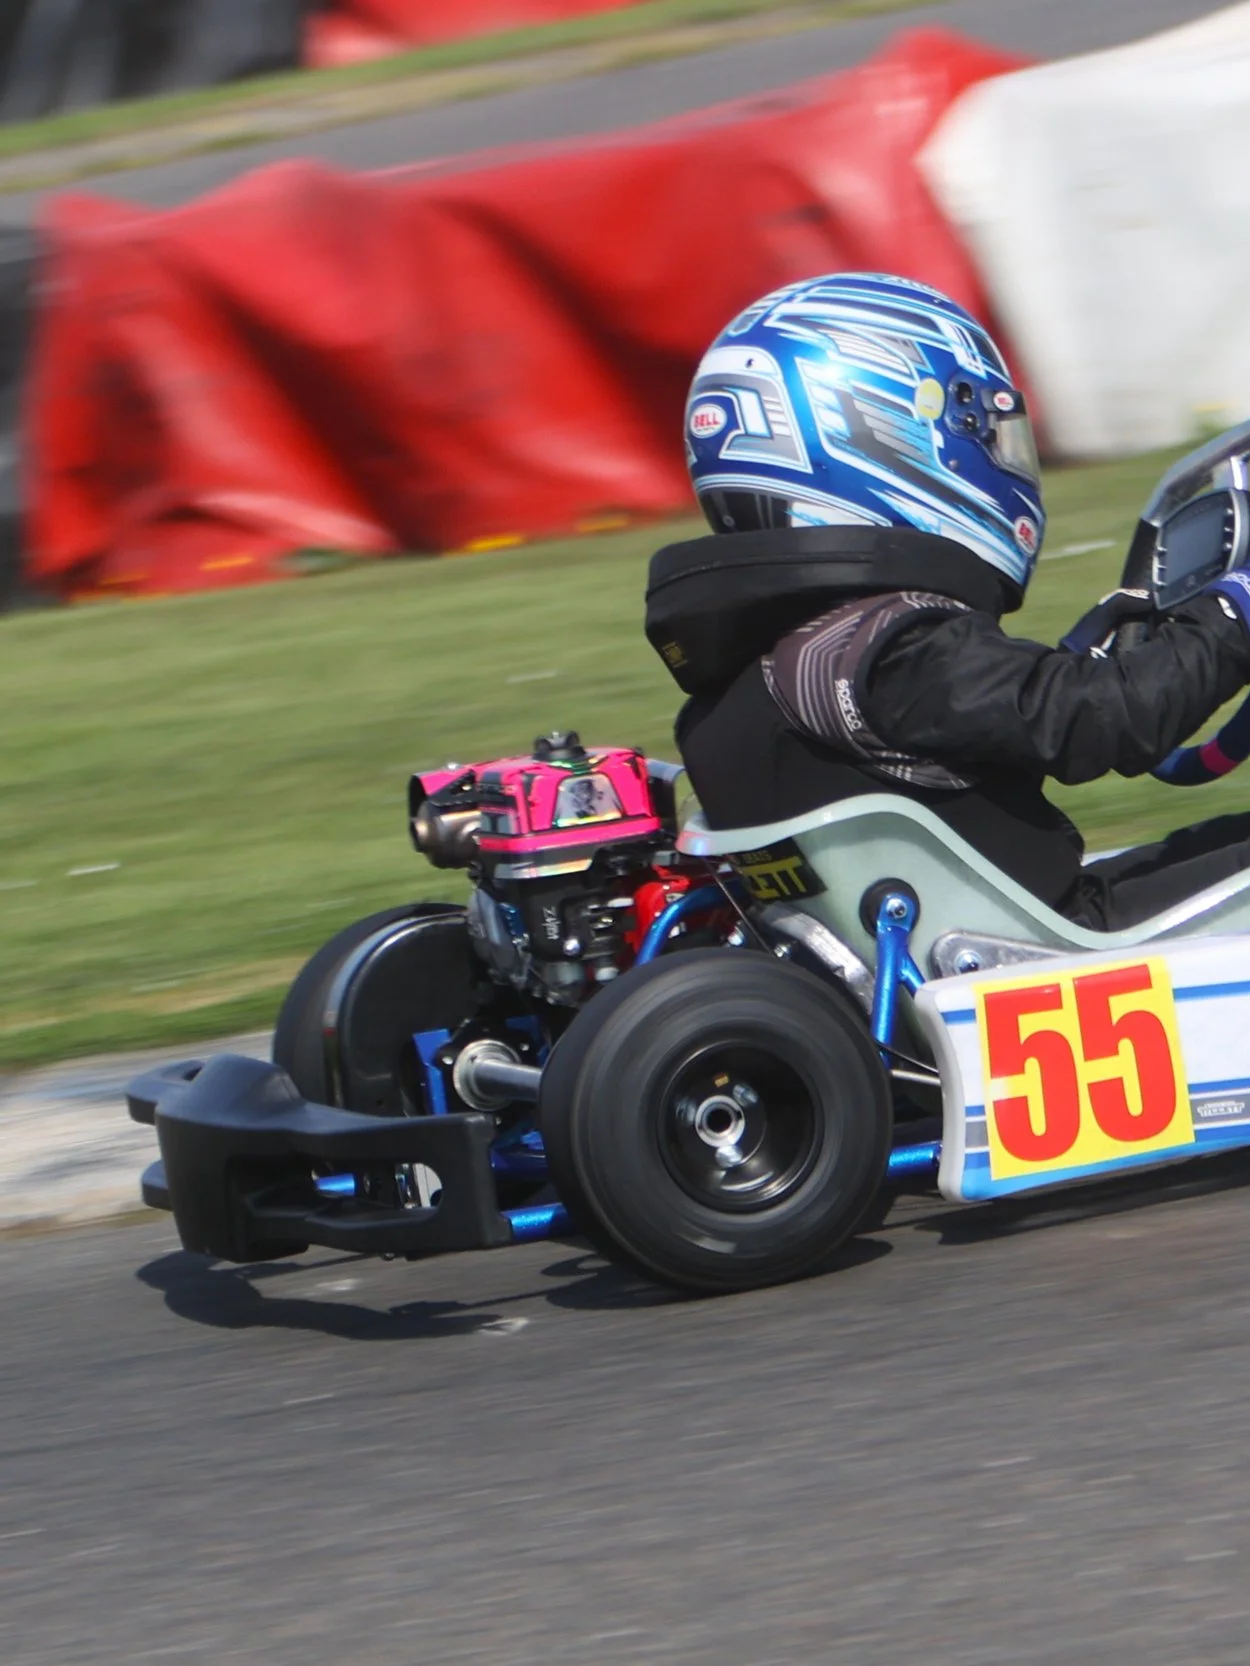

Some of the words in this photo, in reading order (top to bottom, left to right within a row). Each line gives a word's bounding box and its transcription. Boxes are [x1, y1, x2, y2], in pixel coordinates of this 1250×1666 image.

[694, 412, 720, 428] BELL
[834, 678, 862, 732] sparco
[983, 963, 1177, 1162] 55
